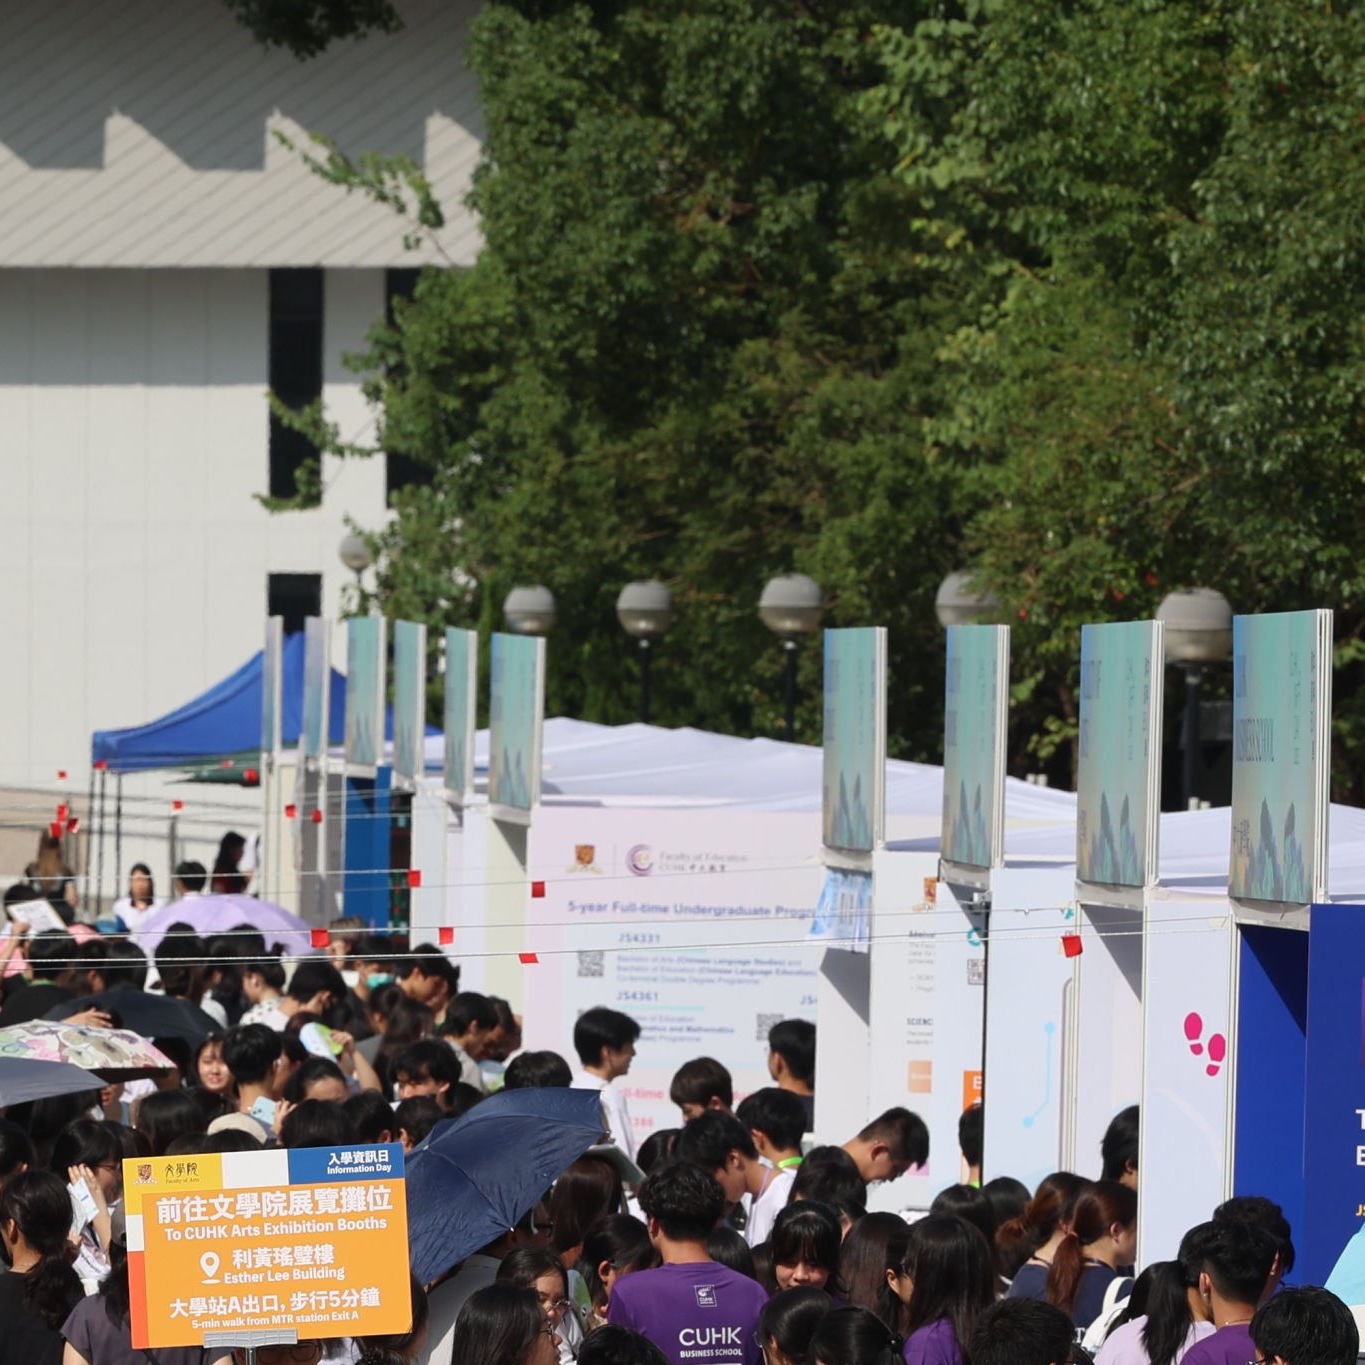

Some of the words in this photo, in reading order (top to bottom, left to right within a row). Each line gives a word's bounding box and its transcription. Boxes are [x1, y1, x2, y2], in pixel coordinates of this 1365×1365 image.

[568, 901, 608, 915] 5-year
[612, 901, 669, 913] Full-time
[673, 902, 770, 916] Undergraduate
[328, 1150, 389, 1165] 入學資訊日
[327, 1165, 375, 1175] Information
[376, 1163, 392, 1174] Day
[156, 1184, 393, 1225] 前往文學院展覽攤位
[165, 1227, 182, 1241] To
[184, 1224, 228, 1240] CUHK
[231, 1223, 261, 1237] Arts
[264, 1219, 334, 1236] Exhibition
[337, 1216, 387, 1231] Booths
[232, 1244, 334, 1270] 利黃瑤璧樓
[224, 1270, 264, 1285] Esther
[266, 1269, 290, 1282] Lee
[293, 1266, 345, 1283] Building
[192, 1319, 220, 1329] 5-min
[221, 1317, 246, 1328] walk
[247, 1315, 270, 1326] from
[272, 1314, 294, 1325] MTR
[296, 1311, 330, 1324] station
[331, 1311, 350, 1322] Exit
[351, 1310, 360, 1321] A
[679, 1326, 742, 1346] CUHK
[680, 1349, 714, 1358] BUSINESS
[715, 1348, 742, 1356] SCHOOL
